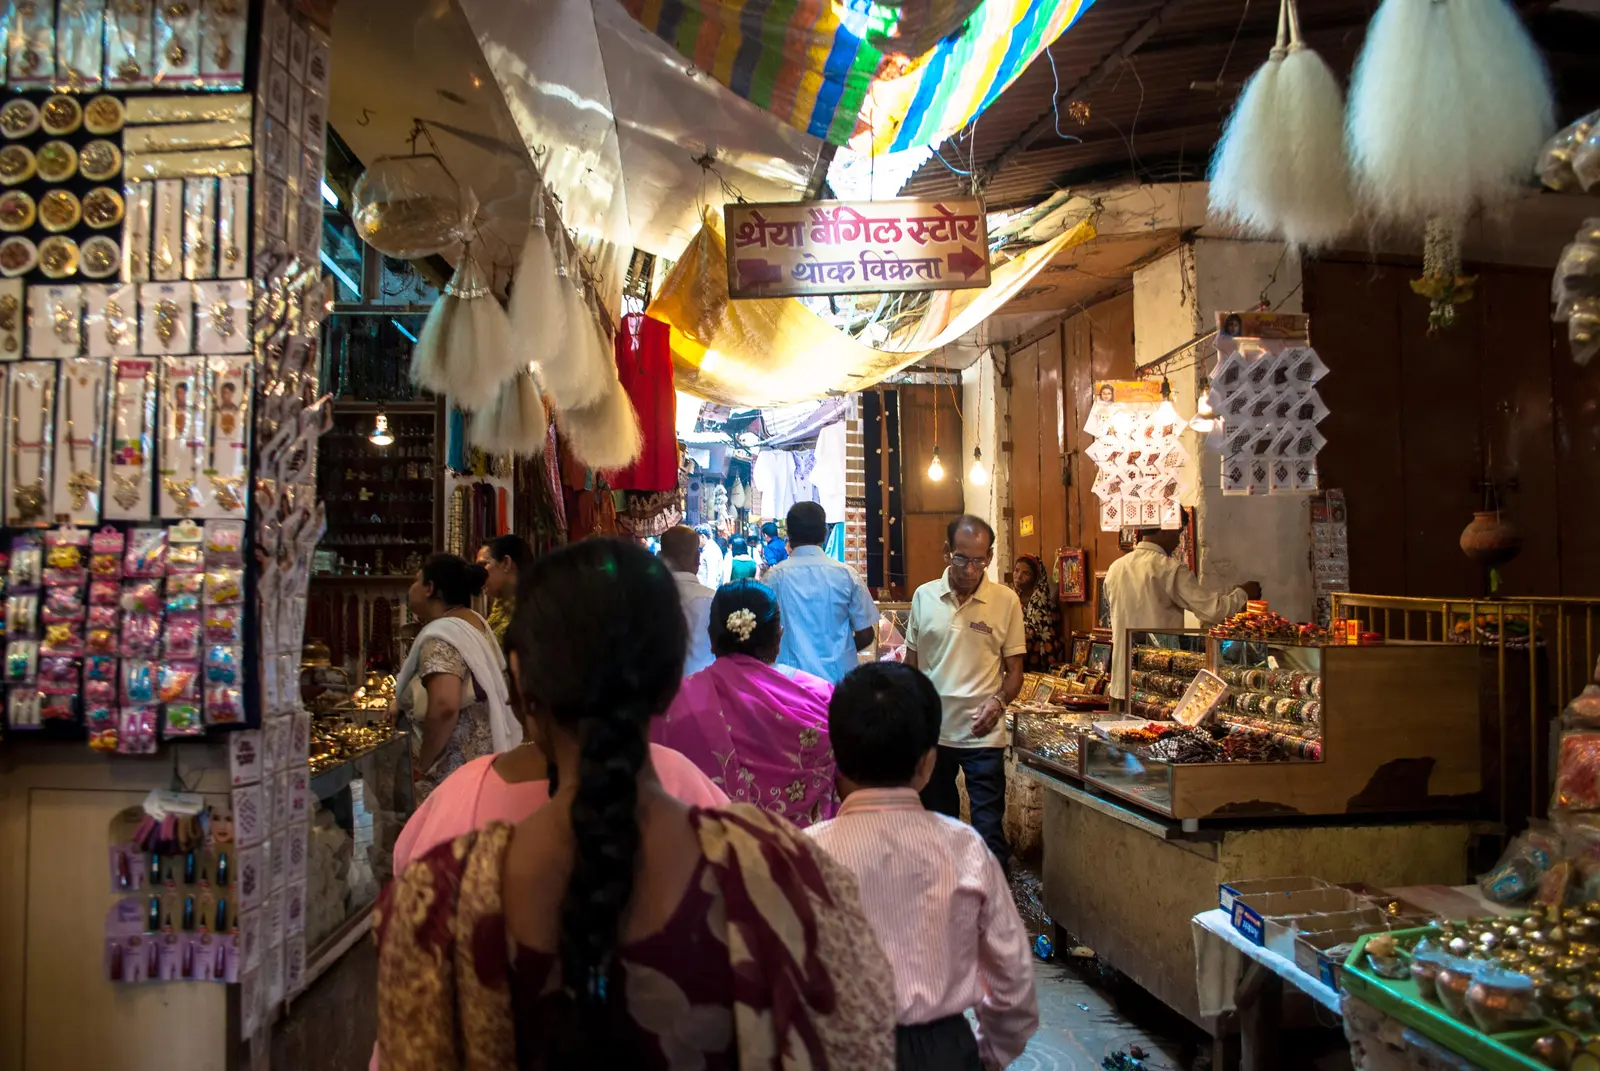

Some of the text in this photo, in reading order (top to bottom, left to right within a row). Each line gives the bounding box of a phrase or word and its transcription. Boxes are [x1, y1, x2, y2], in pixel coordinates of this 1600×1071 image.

[735, 203, 979, 248] श्रेया बैंगिल स्टोर
[791, 250, 943, 284] थोक विक्रेता
